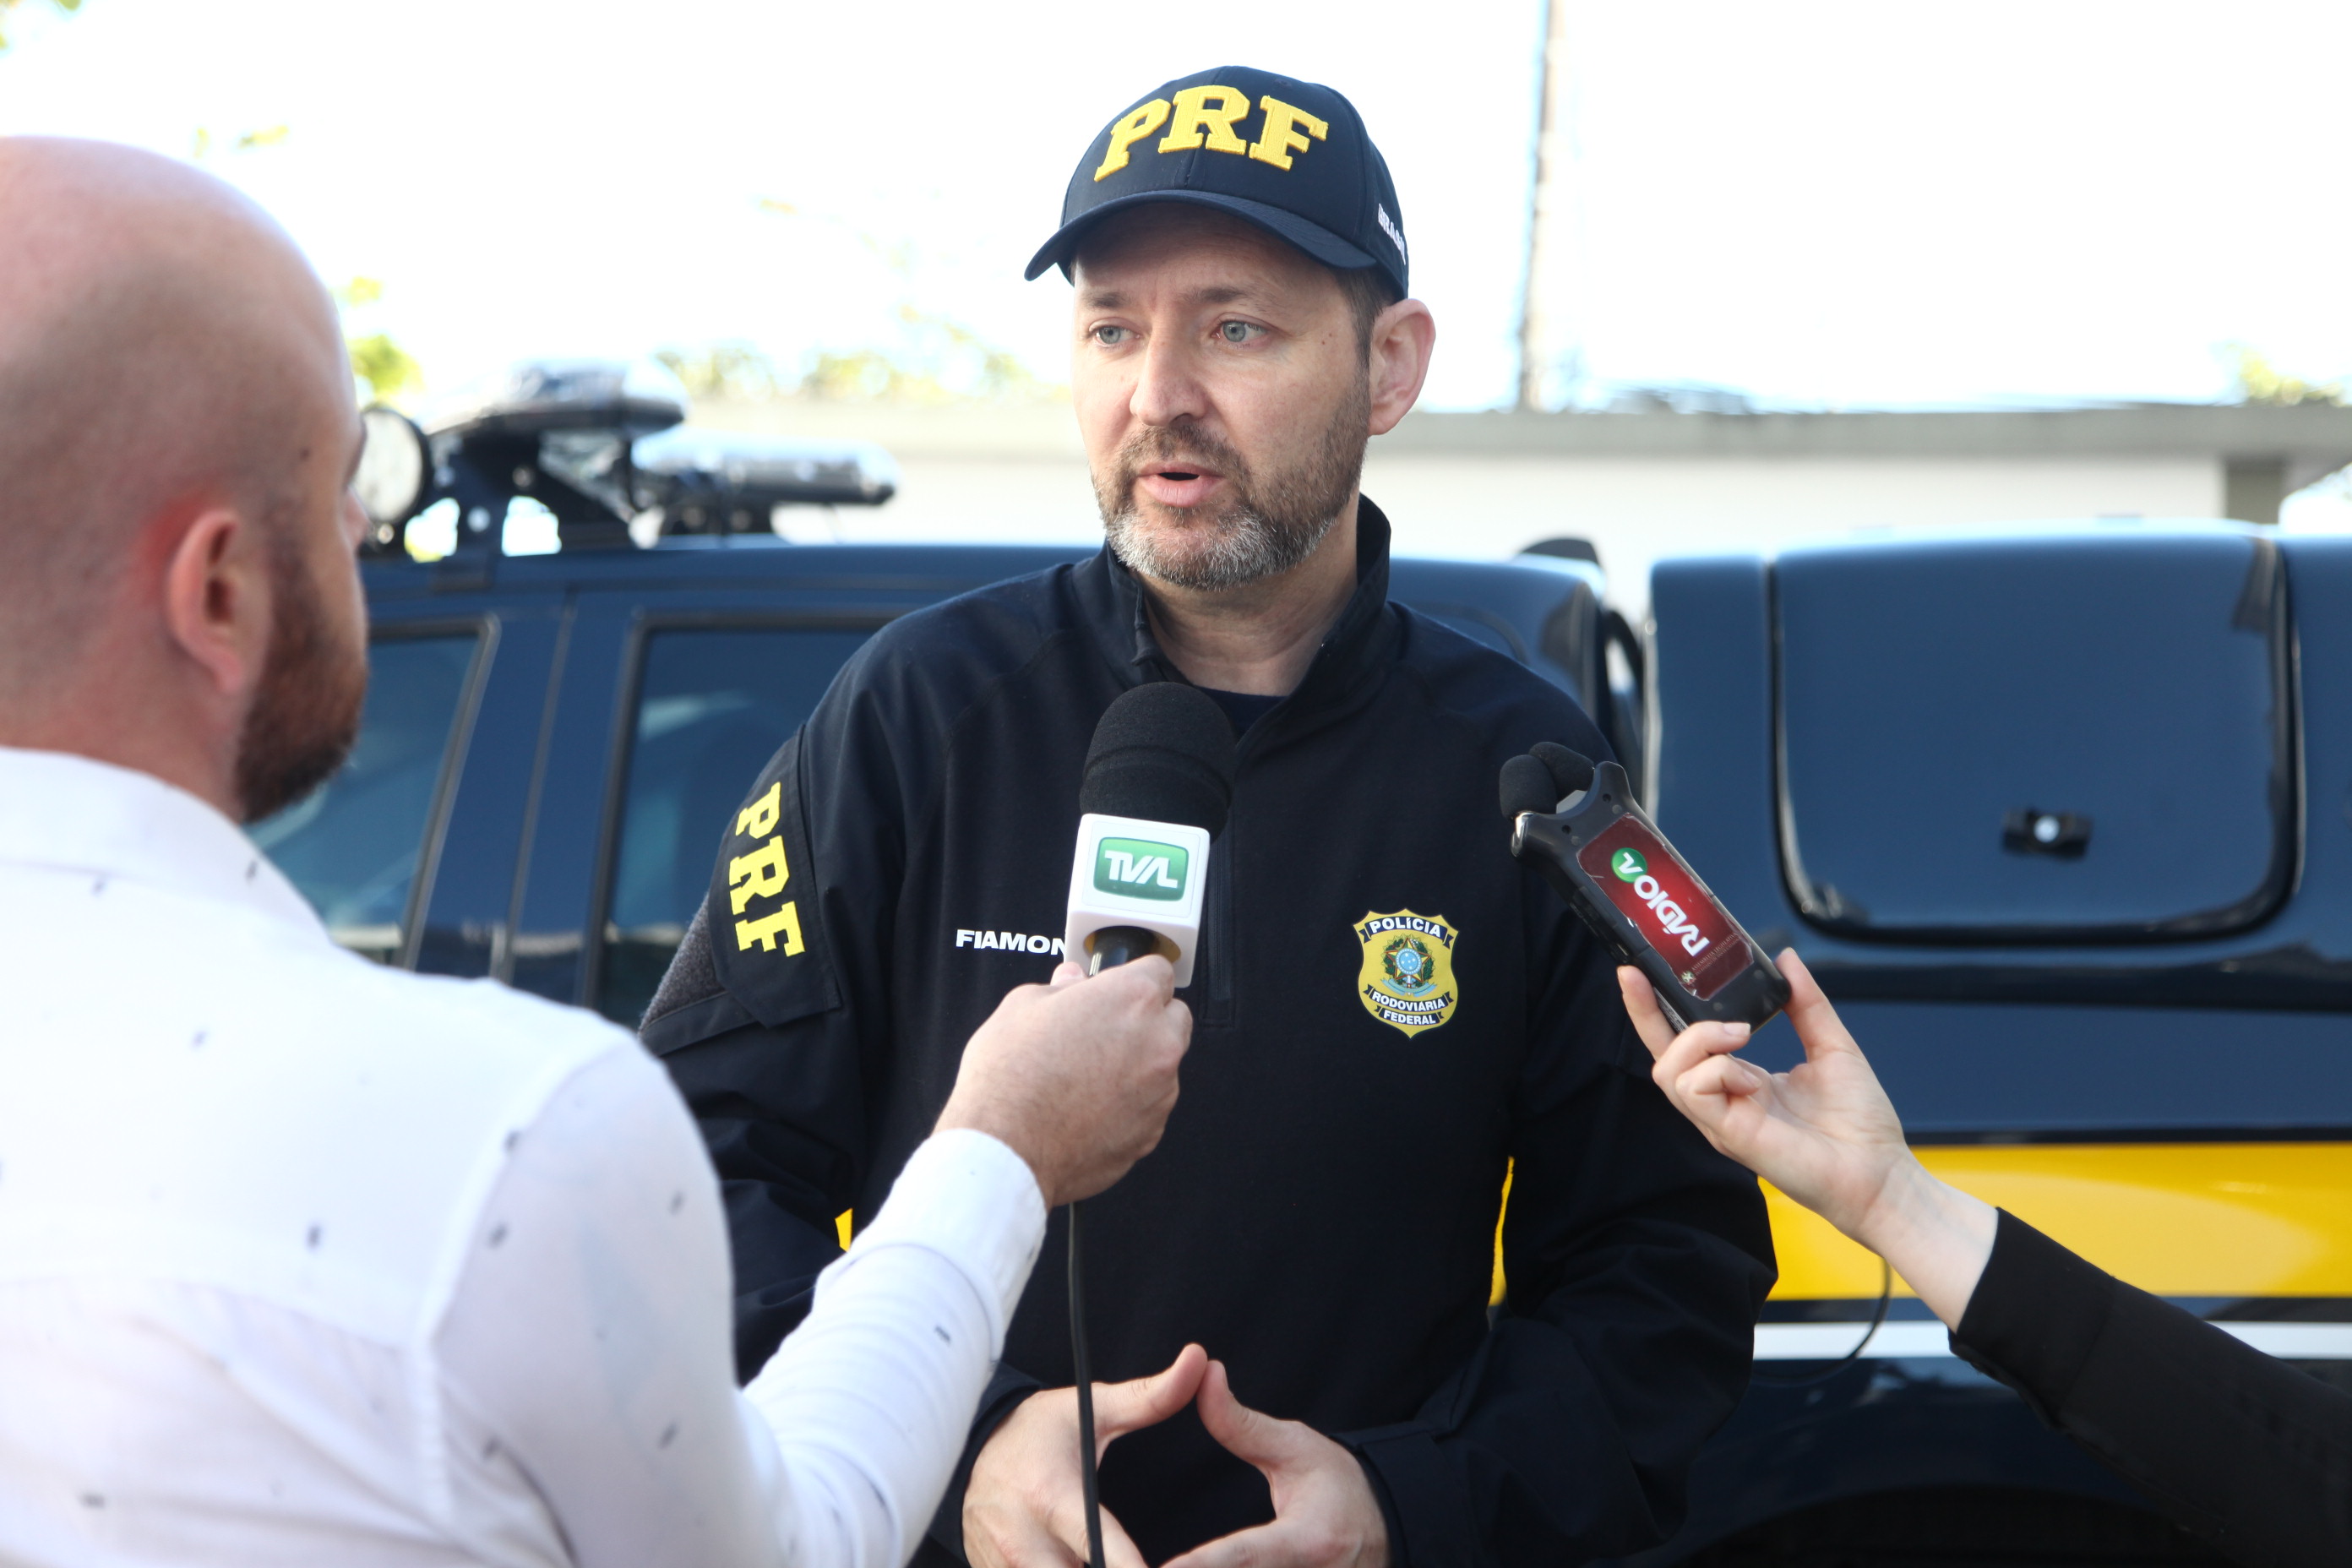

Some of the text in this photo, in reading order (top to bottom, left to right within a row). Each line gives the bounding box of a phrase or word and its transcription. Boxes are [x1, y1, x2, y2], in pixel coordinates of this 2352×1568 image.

[1094, 85, 1329, 181] PRF
[729, 781, 805, 956] PRF
[1369, 917, 1441, 938] POLÍCIA
[1383, 1010, 1436, 1025] FEDERAL
